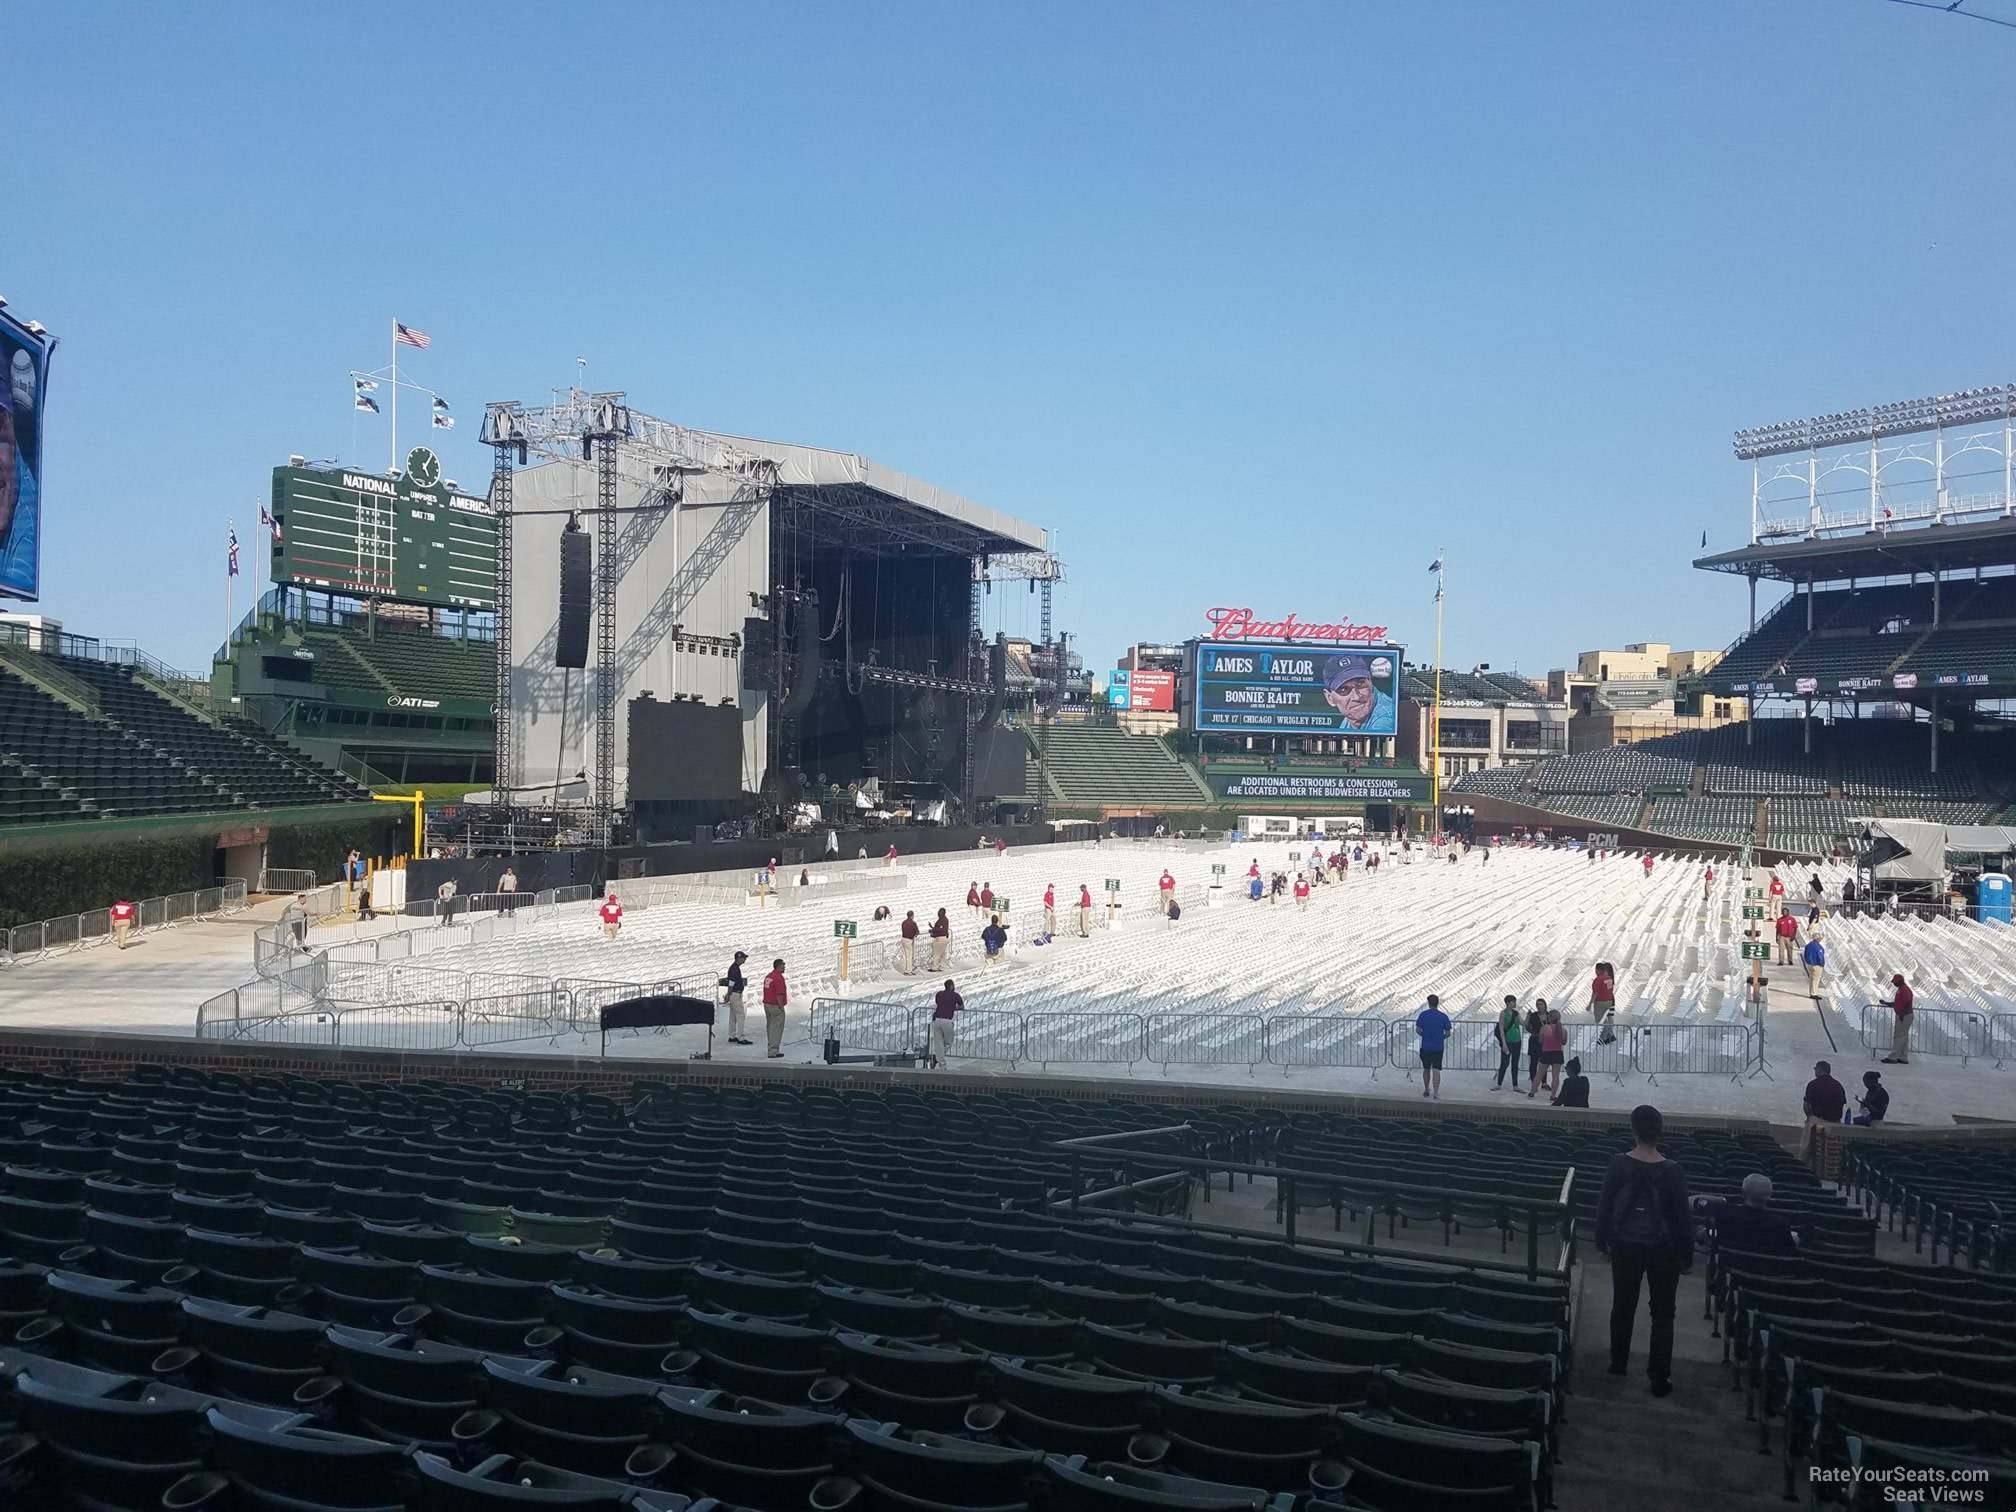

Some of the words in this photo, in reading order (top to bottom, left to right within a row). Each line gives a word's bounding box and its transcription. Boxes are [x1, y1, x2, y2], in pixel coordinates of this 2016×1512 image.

[343, 474, 397, 496] NATIONAL
[410, 490, 438, 503] UMPIRES
[411, 510, 435, 522] BATTER
[1206, 607, 1388, 640] Budweiser
[1206, 652, 1253, 673] JAMES
[1260, 654, 1314, 676] TAYLOR
[1935, 673, 1958, 684] JAMES
[1960, 672, 1989, 683] TAYLOR
[1730, 682, 1749, 691] JAMES
[1751, 681, 1774, 690] TAYLOR
[400, 698, 422, 707] ATI
[1225, 690, 1264, 703] BONNIE
[1267, 692, 1301, 704] RAITT
[1212, 714, 1229, 723] JULY
[1231, 715, 1239, 723] 17
[1243, 715, 1272, 724] CHICAGO
[1277, 716, 1309, 725] WRIGLEY
[1311, 717, 1332, 726] FIELD
[1241, 777, 1288, 787] ADDITIONAL
[1290, 778, 1337, 788] RESTROOMS
[1338, 778, 1345, 788] &
[1346, 778, 1398, 788] CONCESSIONS
[1227, 786, 1242, 795] ARE
[1244, 786, 1278, 795] LOCATED
[1280, 787, 1306, 796] UNDER
[1308, 787, 1323, 796] THE
[1325, 788, 1368, 797] BUDWEISER
[1370, 788, 1411, 798] BLEACHERS
[1587, 833, 1619, 847] PCM
